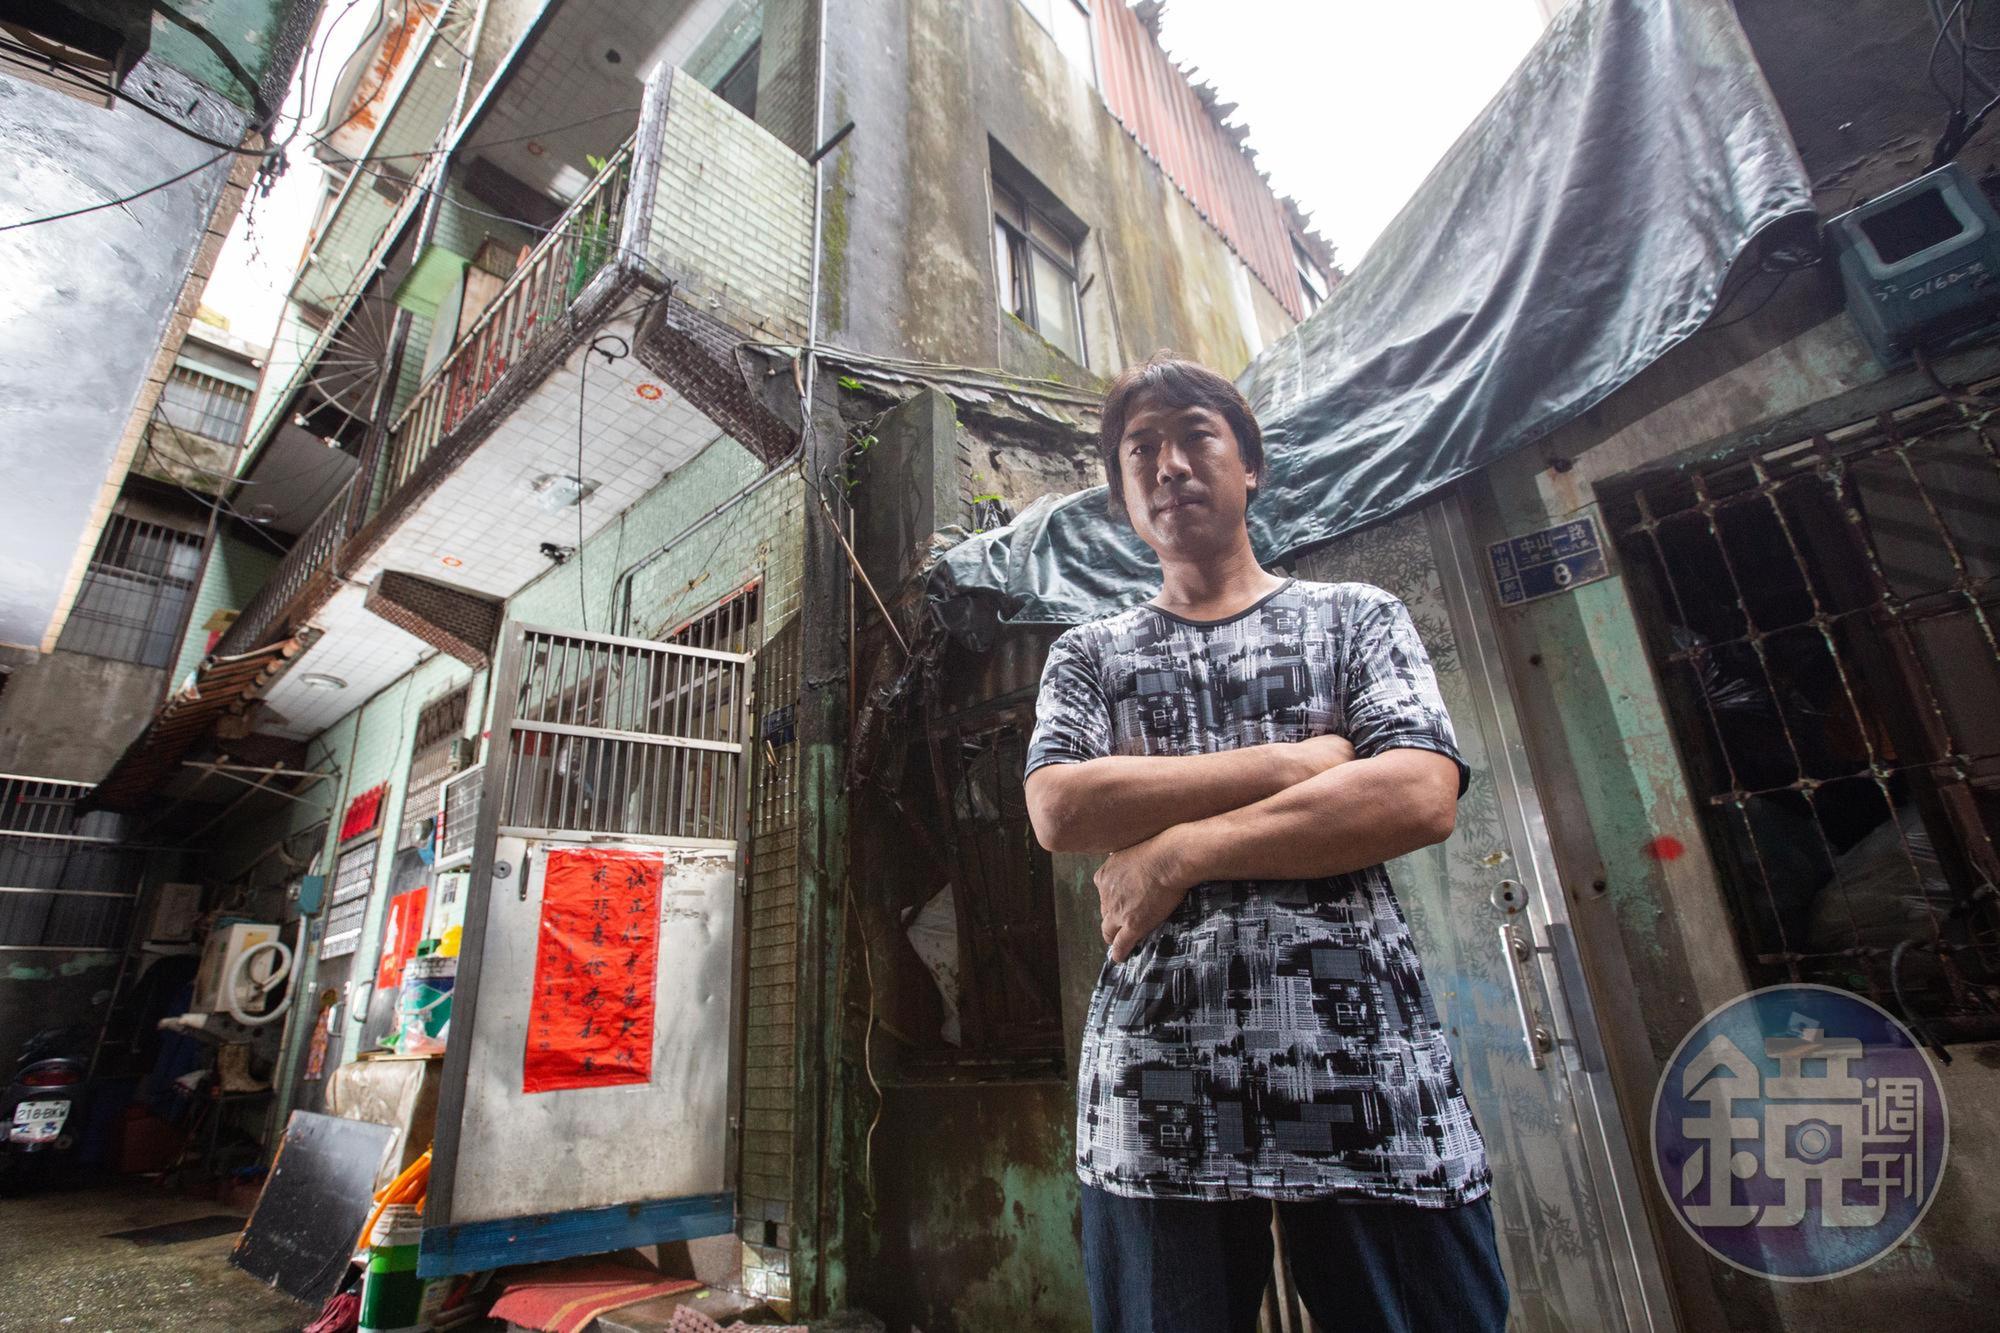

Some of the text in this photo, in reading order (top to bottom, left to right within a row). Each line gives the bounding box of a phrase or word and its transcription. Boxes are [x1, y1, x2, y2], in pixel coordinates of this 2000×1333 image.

[1520, 524, 1587, 554] 中山一路
[1553, 563, 1573, 586] 8
